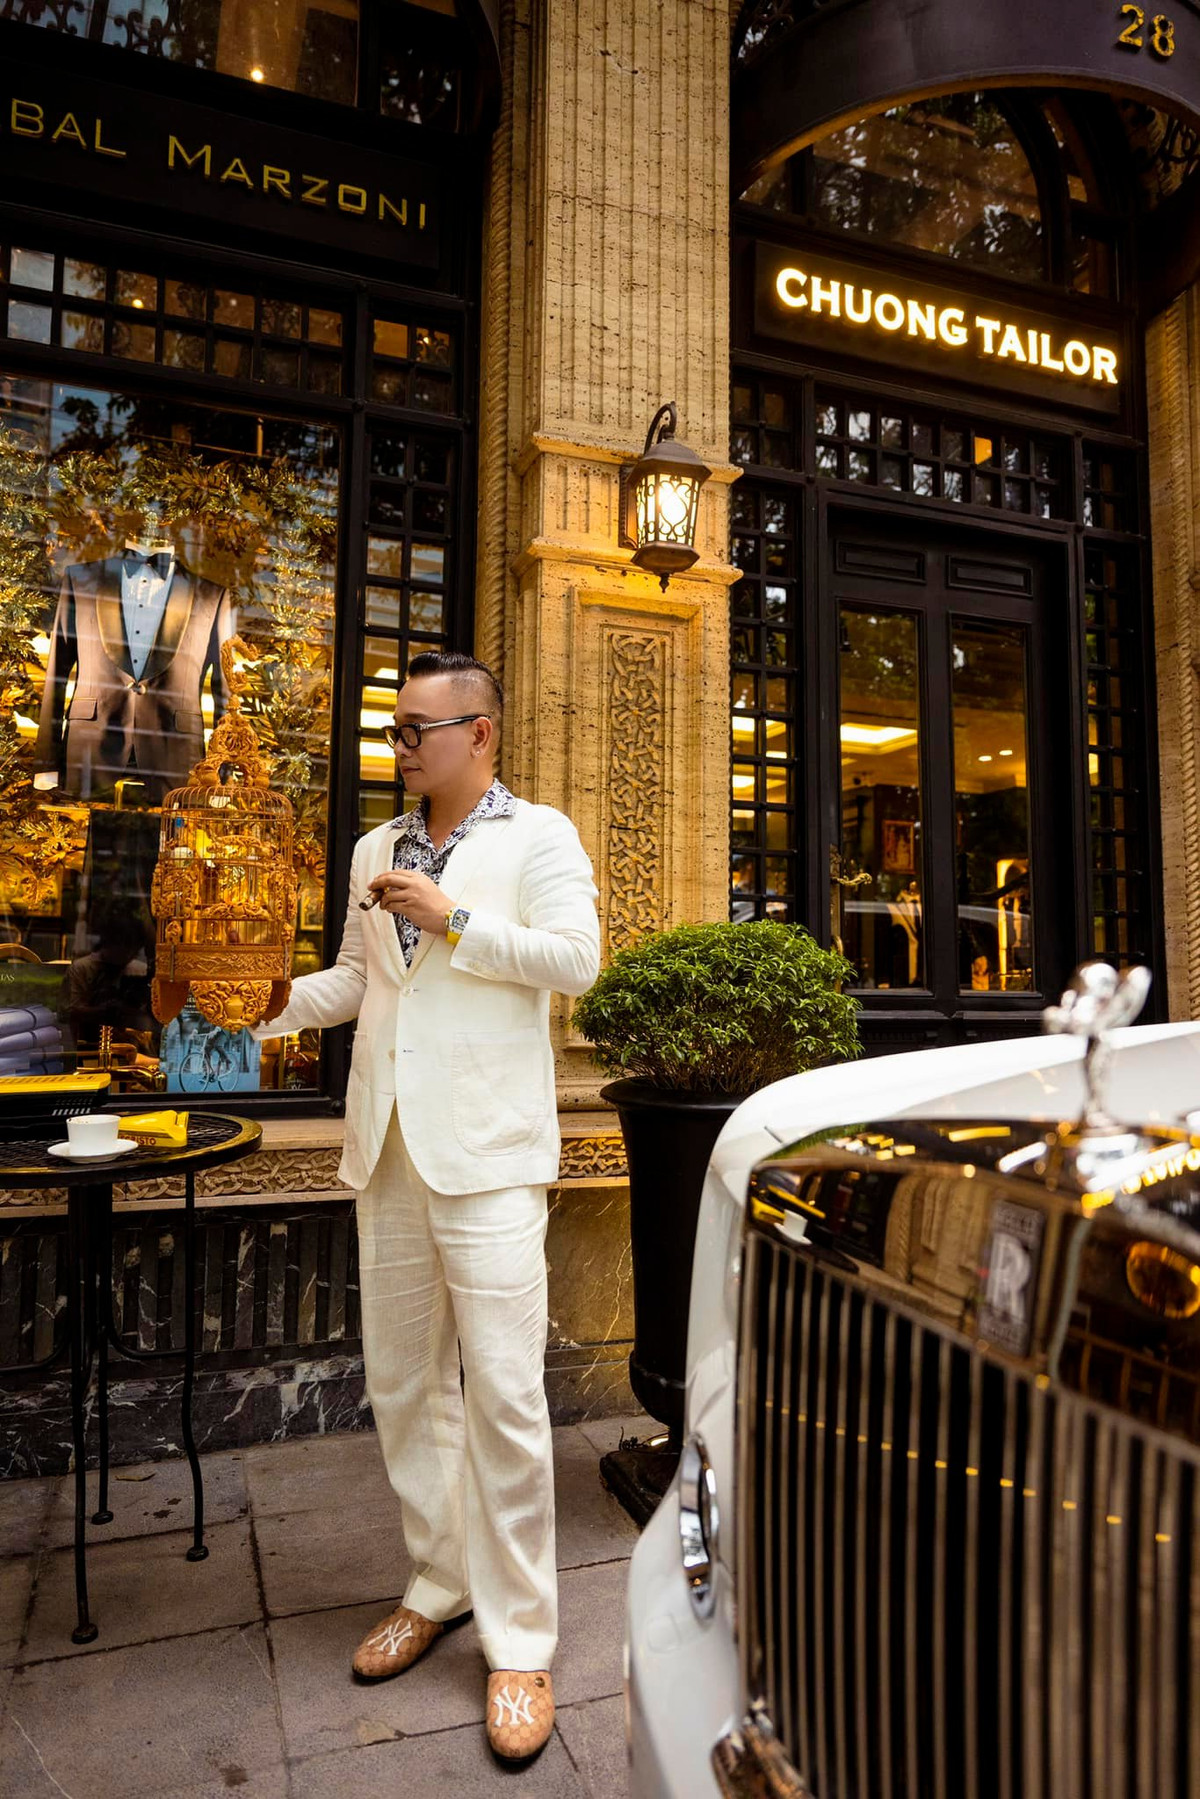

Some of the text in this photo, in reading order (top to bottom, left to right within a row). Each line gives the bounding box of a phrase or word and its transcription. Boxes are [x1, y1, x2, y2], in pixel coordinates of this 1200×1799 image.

[1119, 4, 1175, 57] 28
[168, 134, 426, 229] MARZONI
[776, 267, 1119, 385] CHUONG TAILOR
[367, 1617, 414, 1656] NY
[493, 1685, 535, 1727] NY
